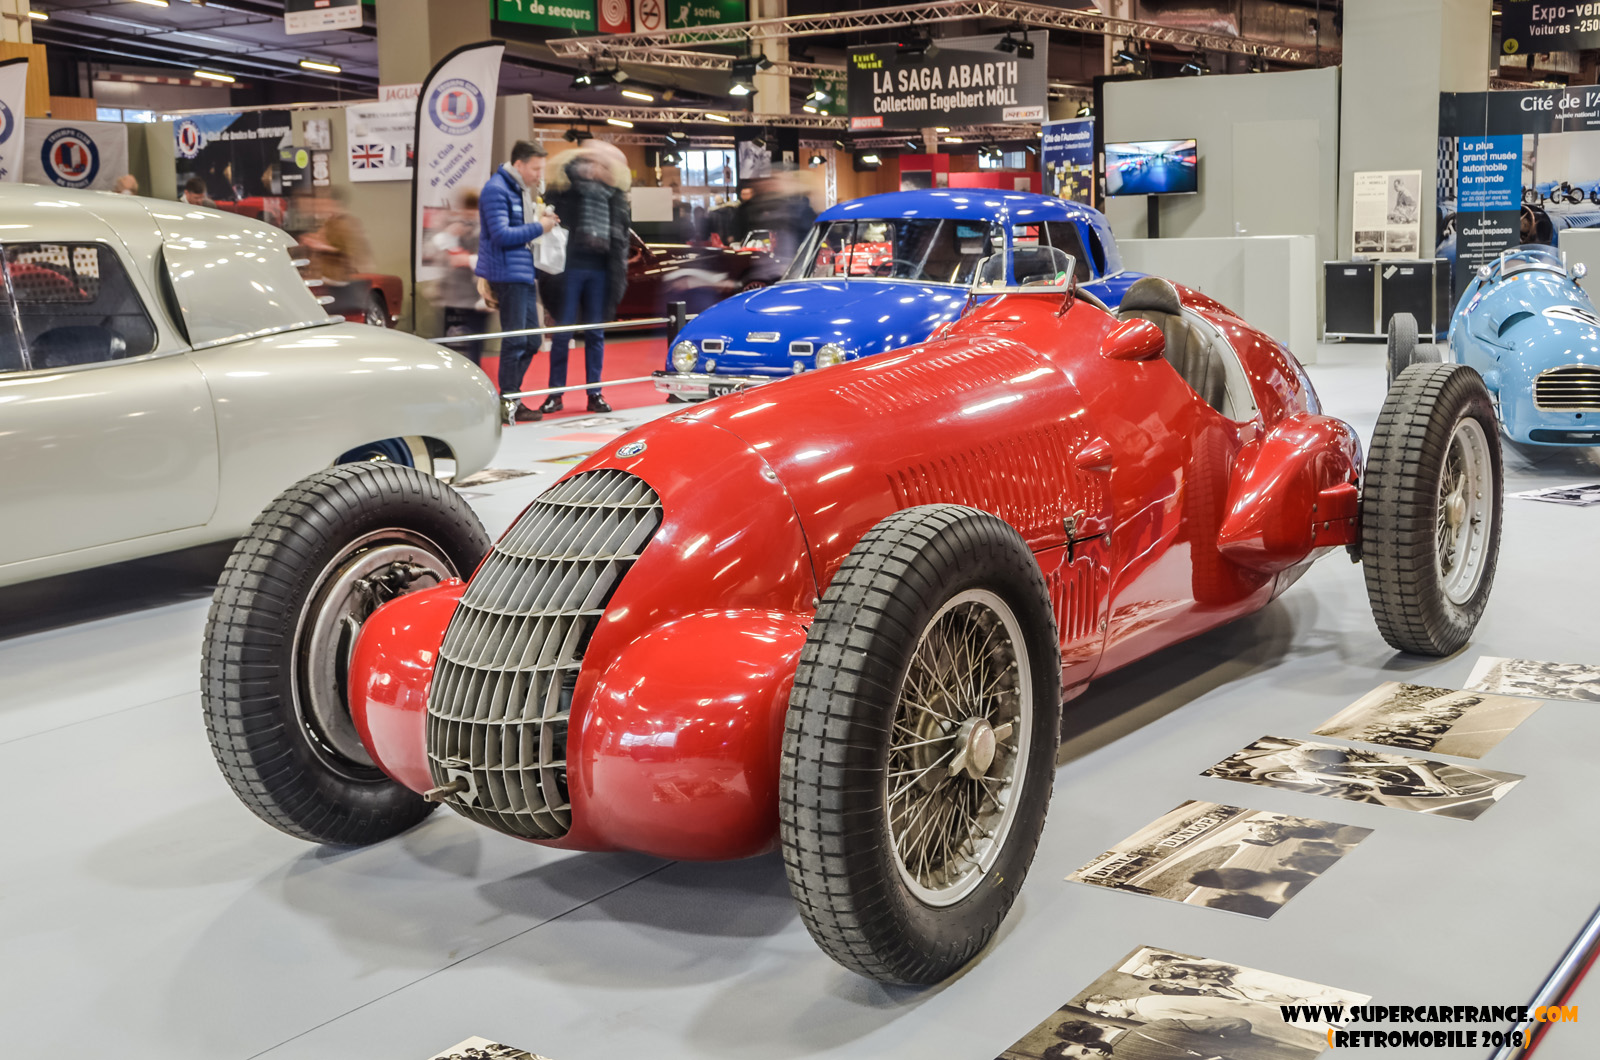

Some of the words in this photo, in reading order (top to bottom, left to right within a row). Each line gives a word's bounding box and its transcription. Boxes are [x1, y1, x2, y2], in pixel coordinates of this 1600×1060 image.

[530, 1, 545, 15] de
[548, 7, 591, 20] secours
[693, 6, 721, 19] sortie
[1529, 24, 1571, 36] Voitures
[1573, 19, 1600, 33] -250
[873, 70, 893, 94] LA
[898, 66, 943, 92] SAGA
[947, 61, 1018, 89] ABARTH
[873, 96, 929, 113] Collection
[930, 91, 984, 112] Engelbert
[986, 85, 1018, 106] MÖLL
[1520, 94, 1554, 111] Cité
[1558, 93, 1581, 109] de
[853, 117, 882, 128] MOTUL
[1555, 111, 1573, 120] Musée
[1574, 110, 1597, 118] national
[437, 143, 454, 160] Club
[1463, 142, 1474, 150] Le
[1475, 141, 1494, 152] plus
[430, 176, 441, 187] de
[438, 153, 463, 177] Toutes
[459, 142, 474, 154] les
[1462, 152, 1488, 163] grand
[1489, 151, 1517, 160] musée
[444, 155, 477, 189] TRIUMPH
[1462, 163, 1508, 173] automobile
[1462, 175, 1473, 184] du
[1474, 174, 1504, 184] monde
[1478, 219, 1492, 227] Les
[1462, 227, 1513, 236] Culturespaces
[1162, 818, 1214, 847] DUNLOP
